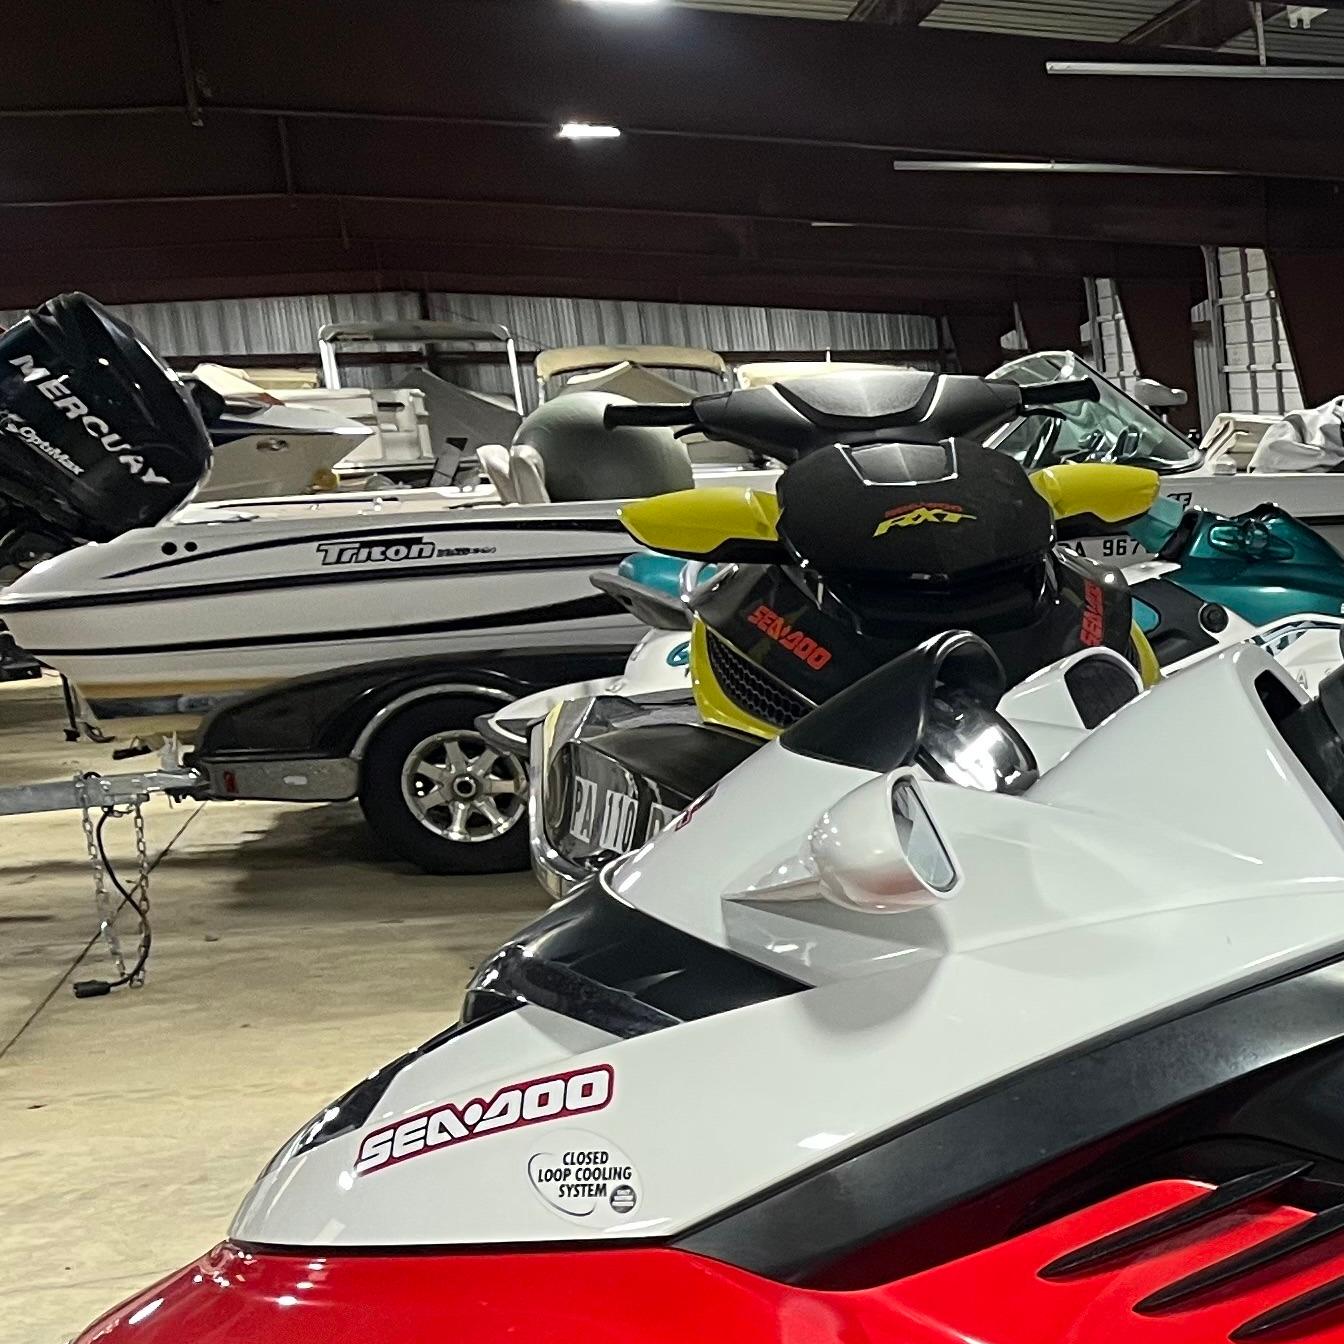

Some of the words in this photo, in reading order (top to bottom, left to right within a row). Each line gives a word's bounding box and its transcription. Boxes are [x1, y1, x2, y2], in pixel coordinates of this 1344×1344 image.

[8, 354, 171, 484] MERCURY
[316, 537, 435, 565] Triton
[562, 1151, 609, 1166] CLOSED
[537, 1168, 572, 1183] LOOP
[574, 1166, 632, 1182] COOLING
[558, 1183, 607, 1198] SYSTEM
